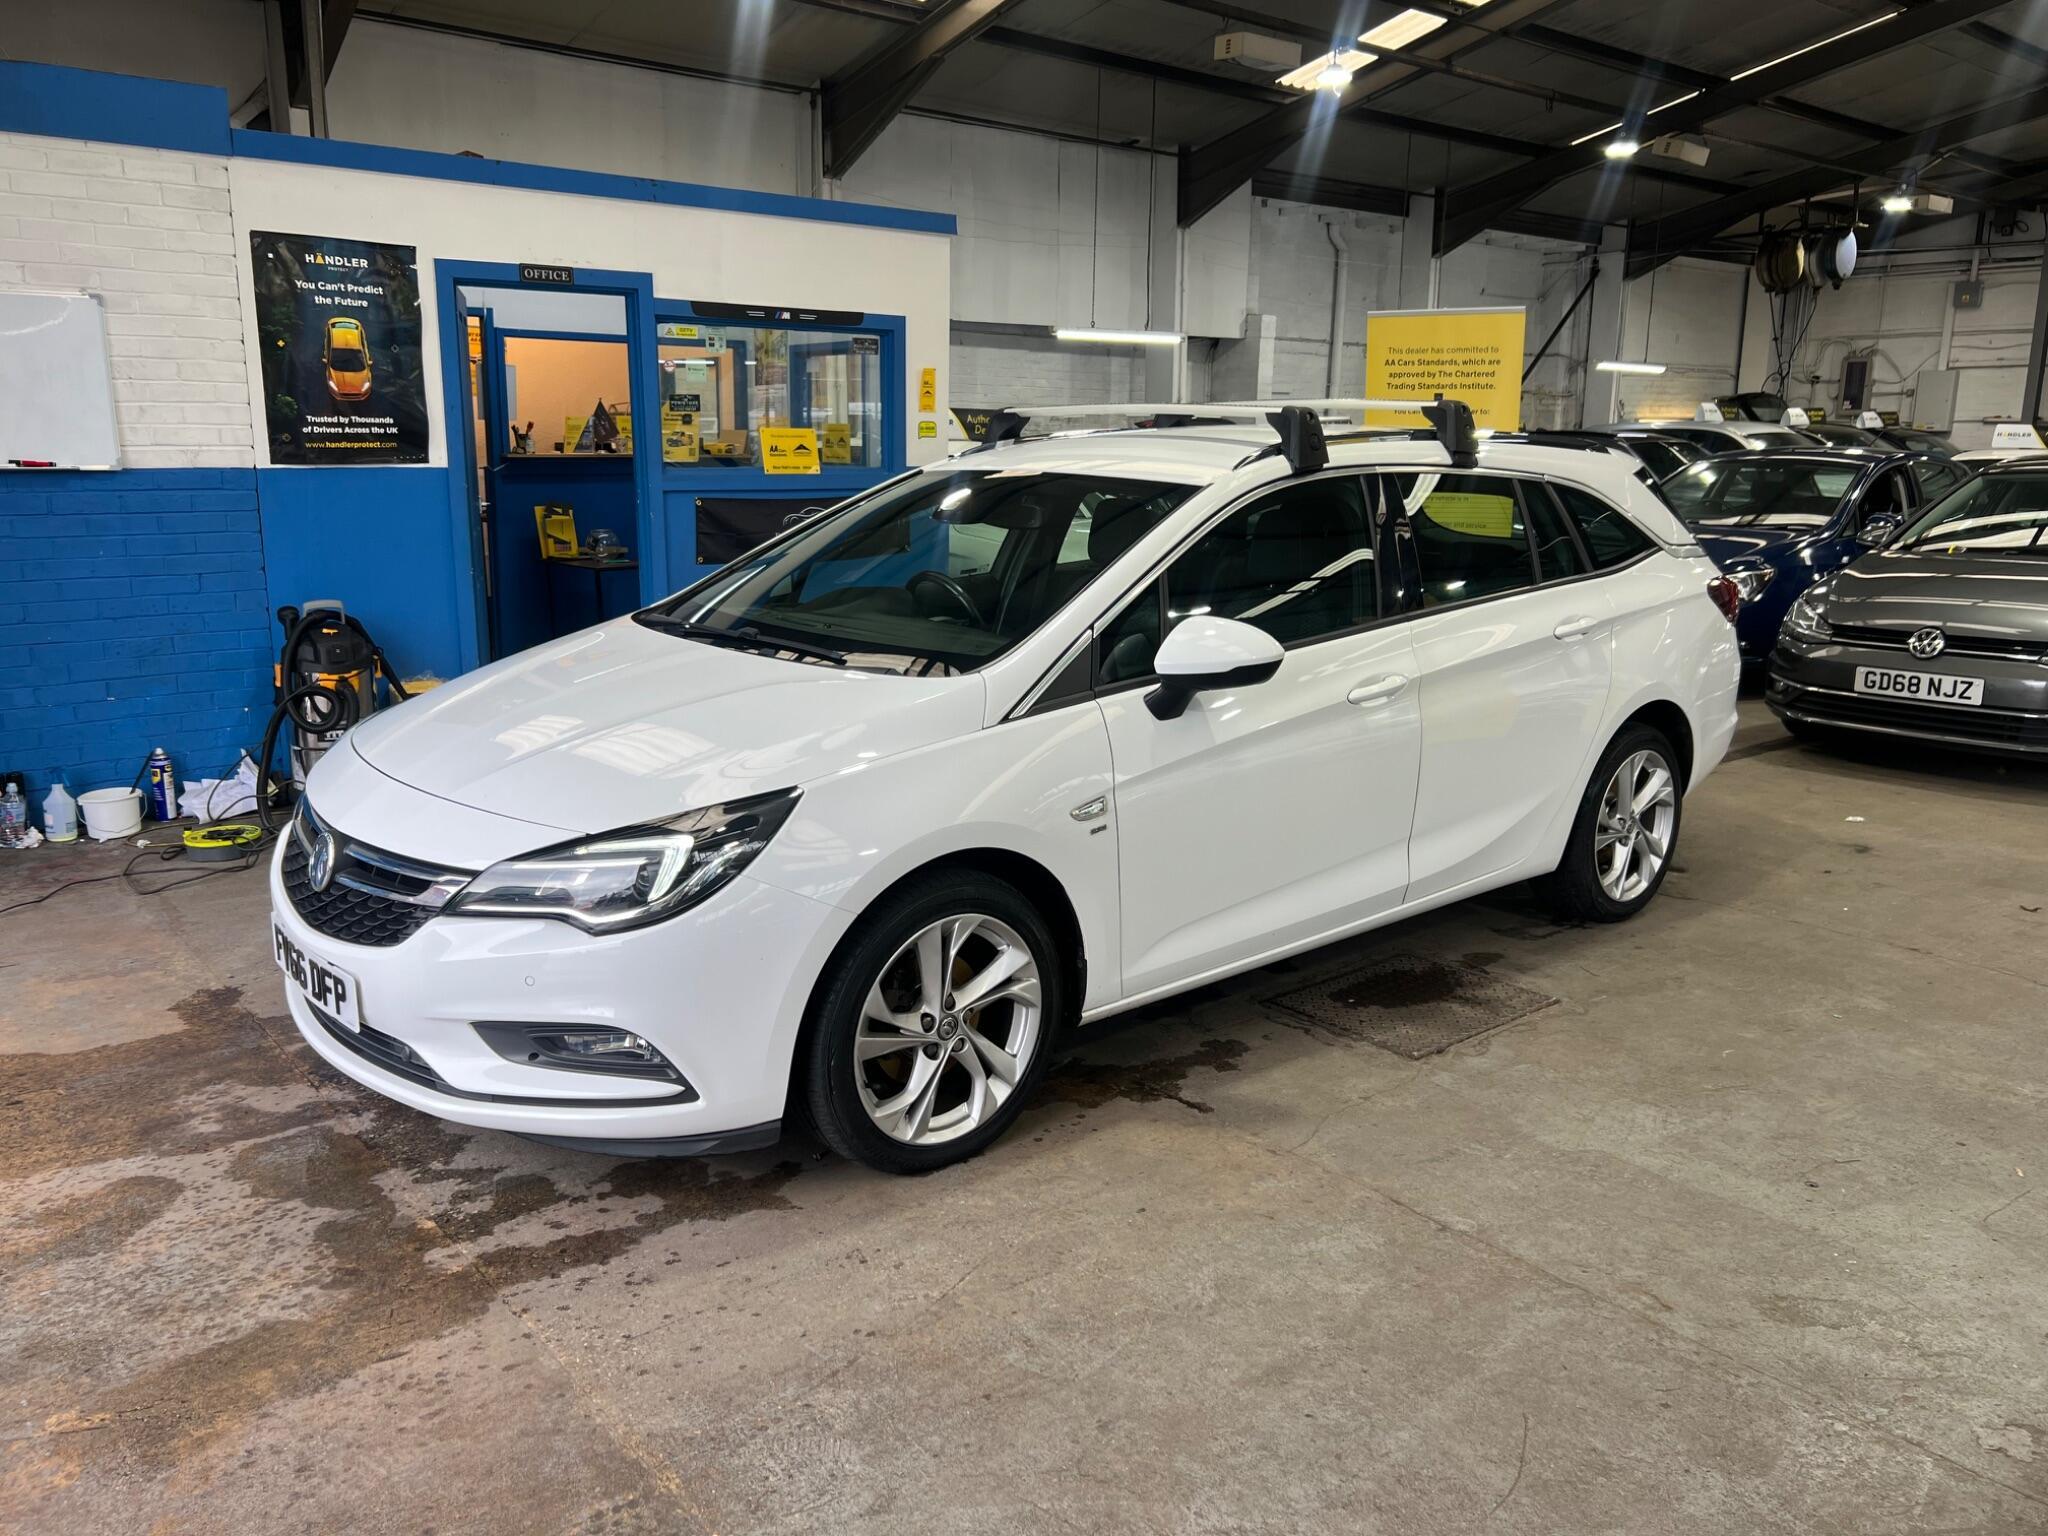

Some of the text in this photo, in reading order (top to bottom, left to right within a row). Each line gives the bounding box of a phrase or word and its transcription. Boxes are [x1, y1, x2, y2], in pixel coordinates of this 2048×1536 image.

[524, 268, 570, 281] OFFICE
[295, 280, 383, 295] You Can't Predict
[314, 295, 368, 307] the Future
[1388, 346, 1499, 355] This dealer has committed to
[1397, 359, 1415, 367] Cars
[1417, 359, 1460, 367] Standards,
[1461, 358, 1486, 366] which
[1388, 370, 1495, 379] approved by The Chartered
[1386, 382, 1496, 391] Trading Standards Institute.
[306, 415, 394, 424] Trusted by Thousands
[302, 425, 312, 434] of
[313, 426, 343, 434] Drivers
[344, 426, 370, 434] Across
[371, 426, 385, 434] the
[305, 441, 397, 449] www.handlerprotect.com
[1863, 670, 1974, 700] GD68 NJZ
[308, 958, 347, 1016] DFP
